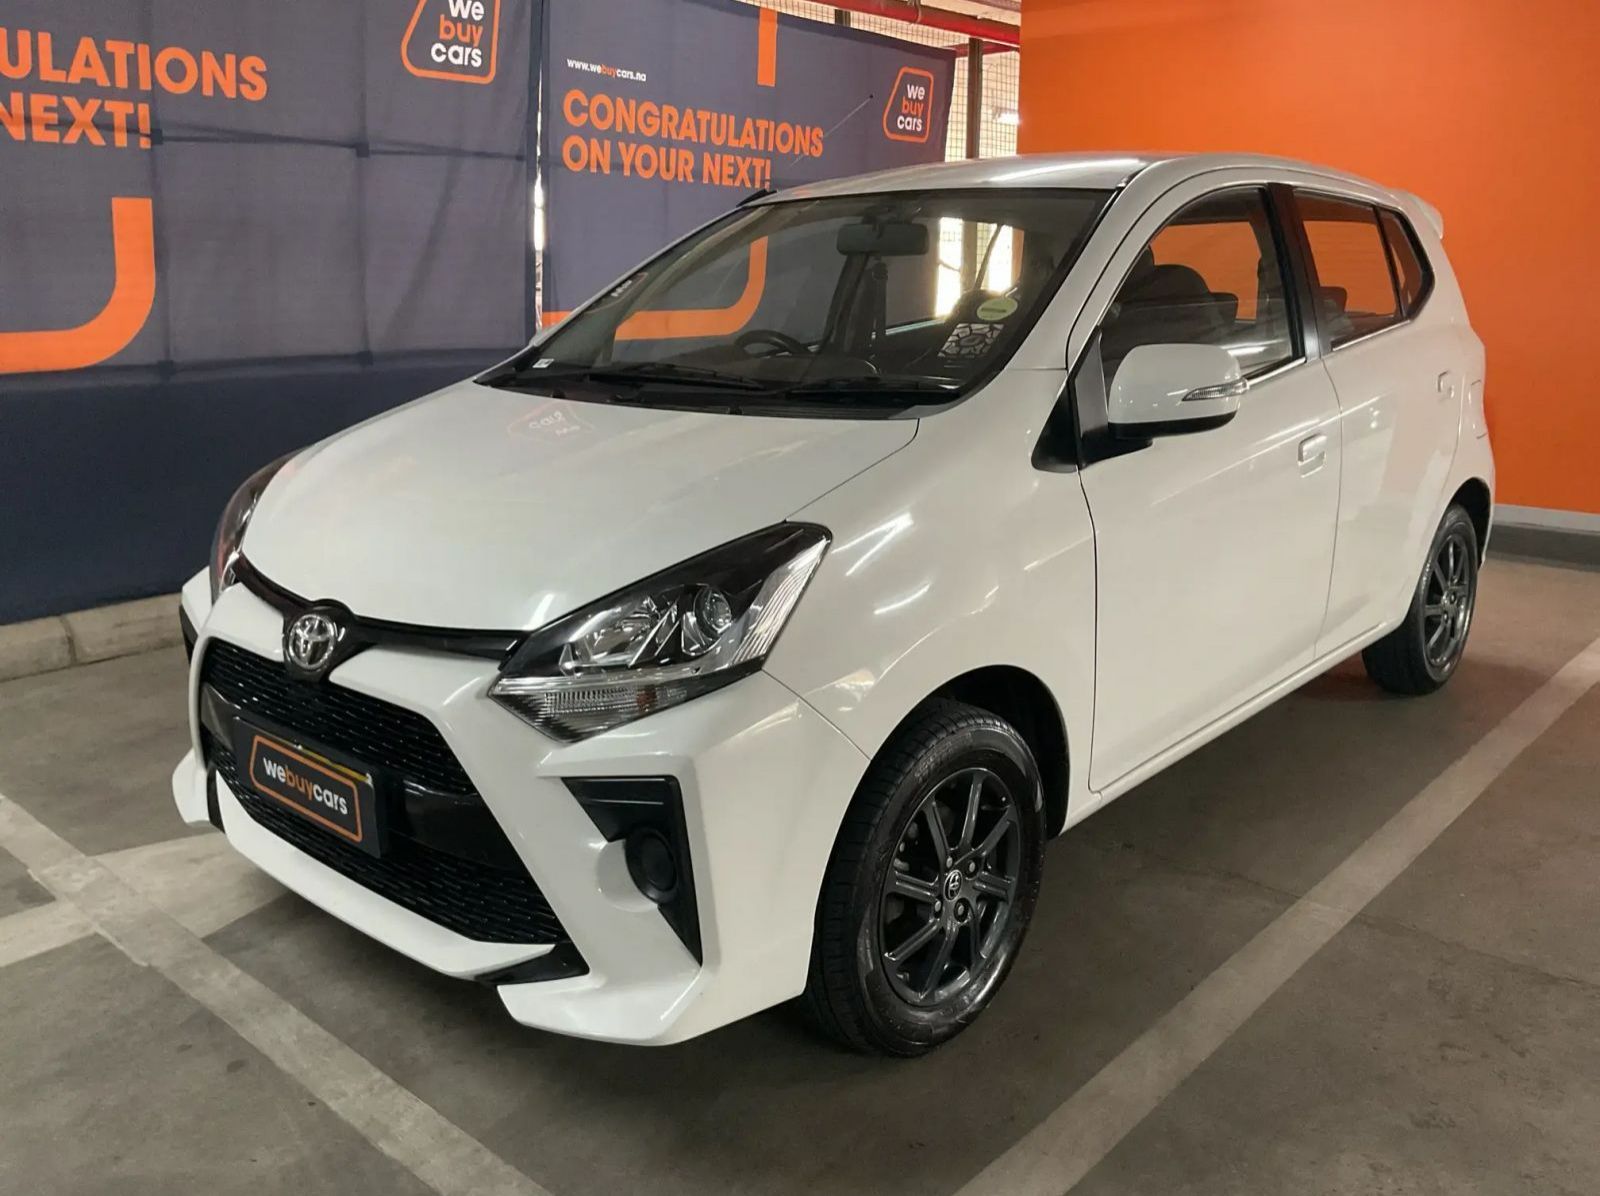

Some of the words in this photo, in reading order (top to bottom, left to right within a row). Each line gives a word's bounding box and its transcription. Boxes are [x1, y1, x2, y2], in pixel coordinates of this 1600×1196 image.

[448, 0, 485, 21] we
[439, 14, 483, 48] buy
[0, 26, 269, 101] ULATIONS
[430, 42, 482, 68] cars
[566, 58, 647, 82] www.webuycars.na
[907, 84, 925, 100] we
[902, 96, 924, 118] buy
[562, 89, 825, 158] CONGRATULATIONS
[897, 115, 922, 132] cars
[561, 134, 612, 174] ON
[617, 140, 695, 183] YOUR
[702, 151, 772, 188] NEXT!
[262, 757, 349, 815] webuycars
